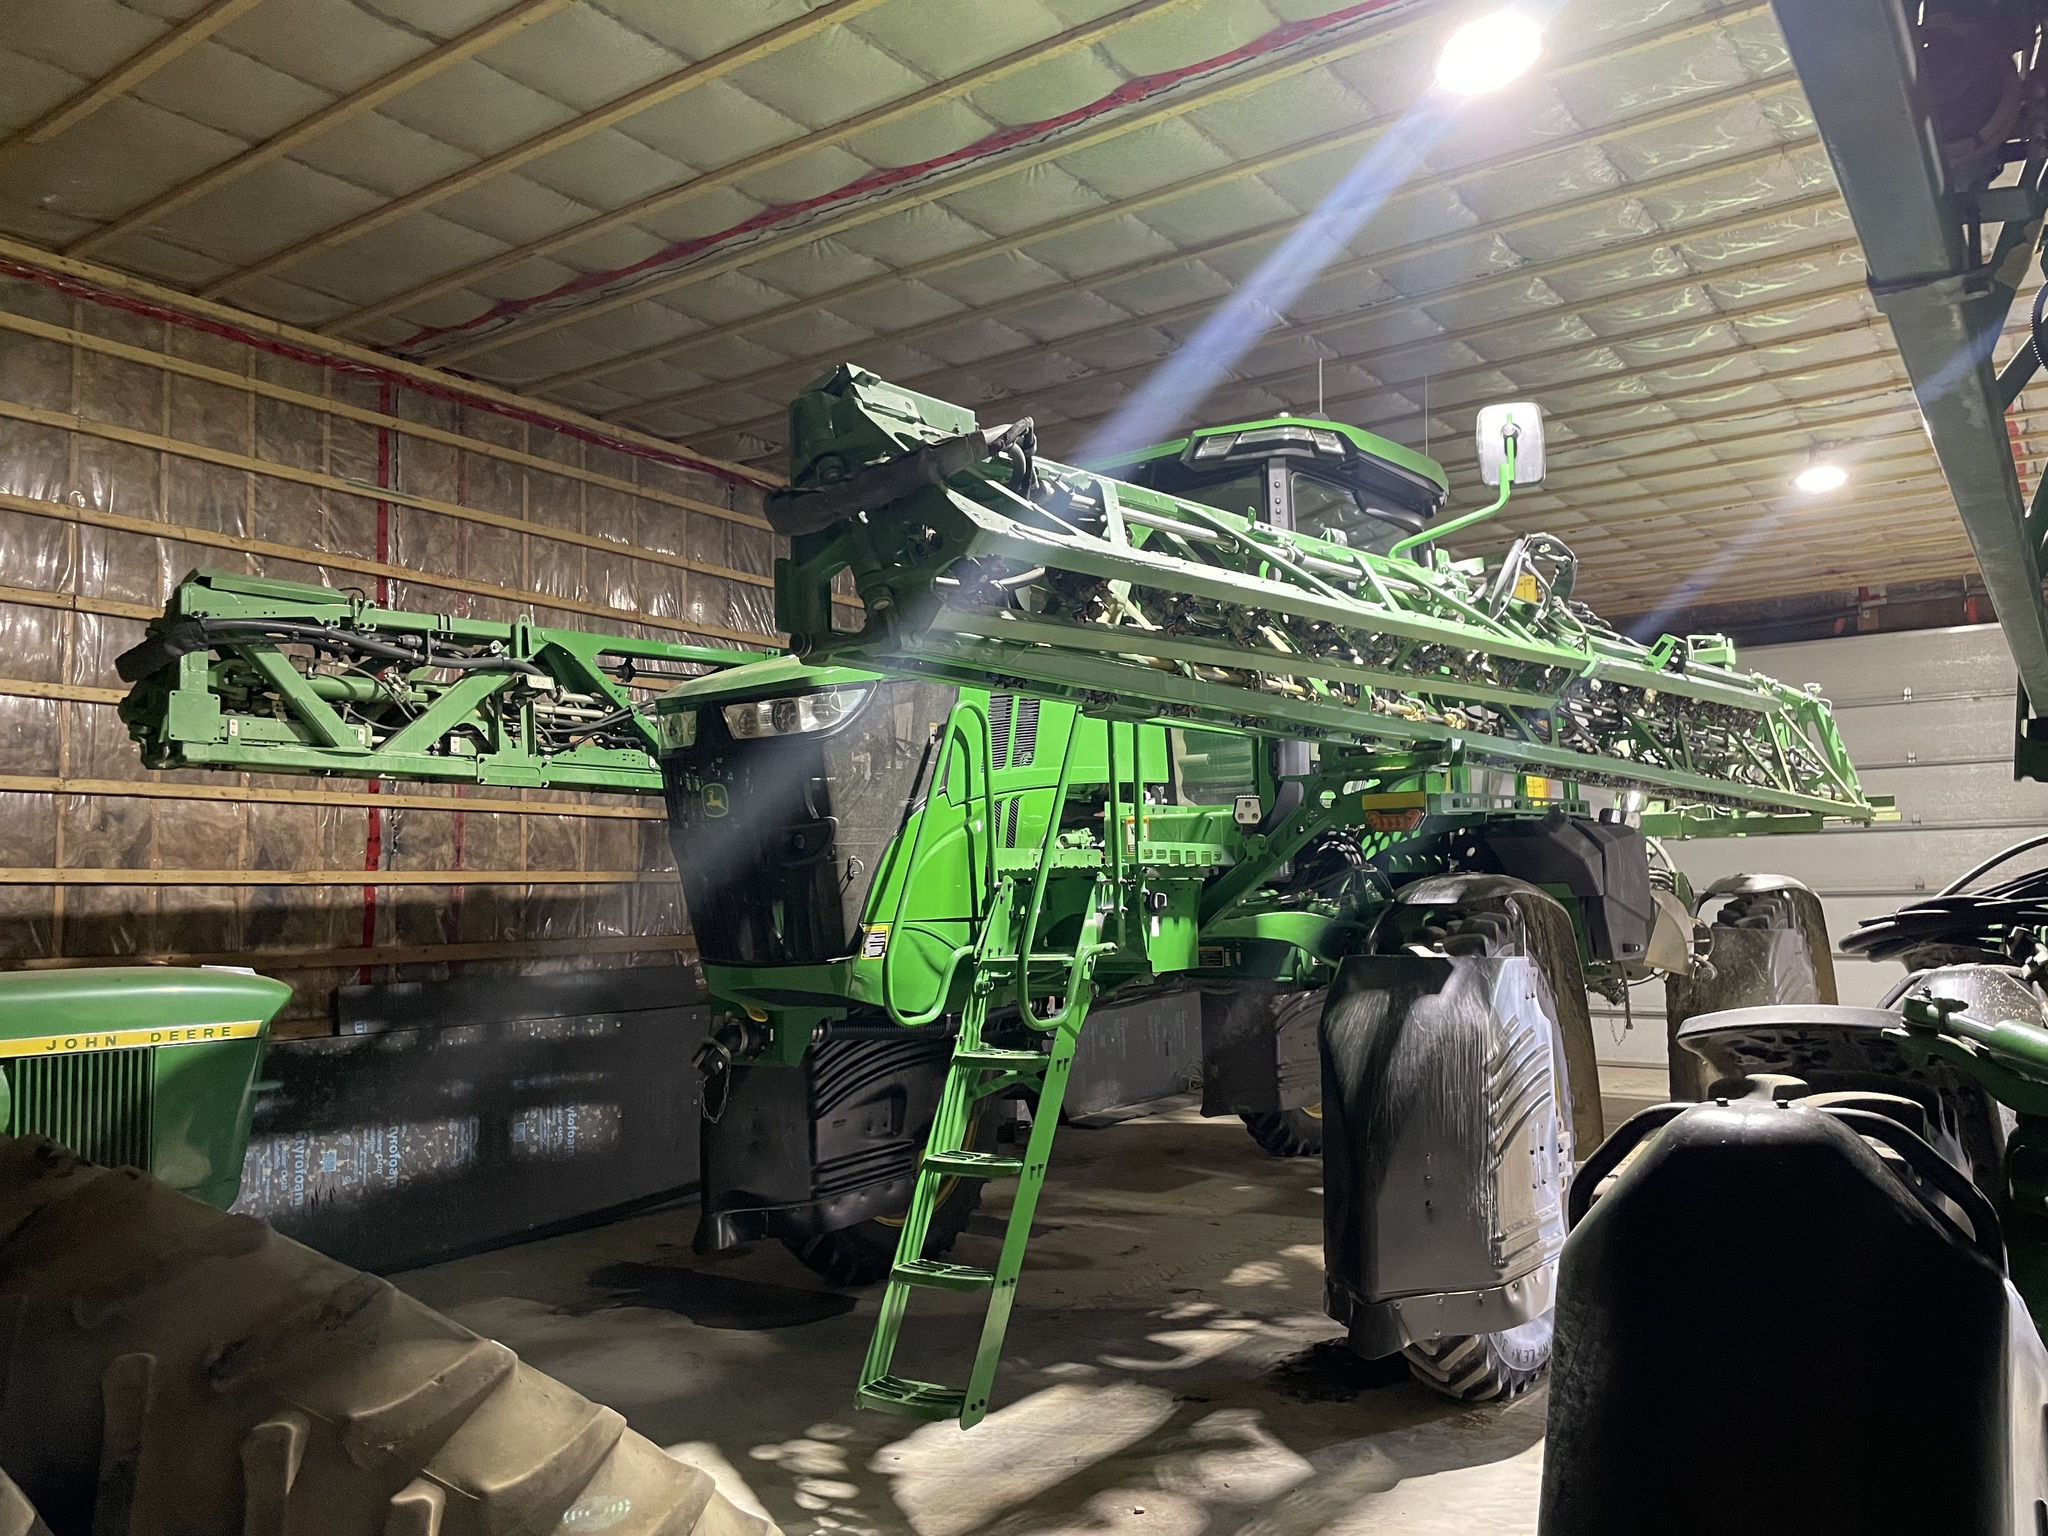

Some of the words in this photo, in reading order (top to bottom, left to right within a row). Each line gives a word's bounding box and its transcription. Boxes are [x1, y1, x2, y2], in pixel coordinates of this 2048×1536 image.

[46, 1035, 117, 1050] JOHN
[150, 1026, 231, 1043] DEERE
[386, 1123, 401, 1188] tyrofoam
[565, 1105, 578, 1157] yrofoam
